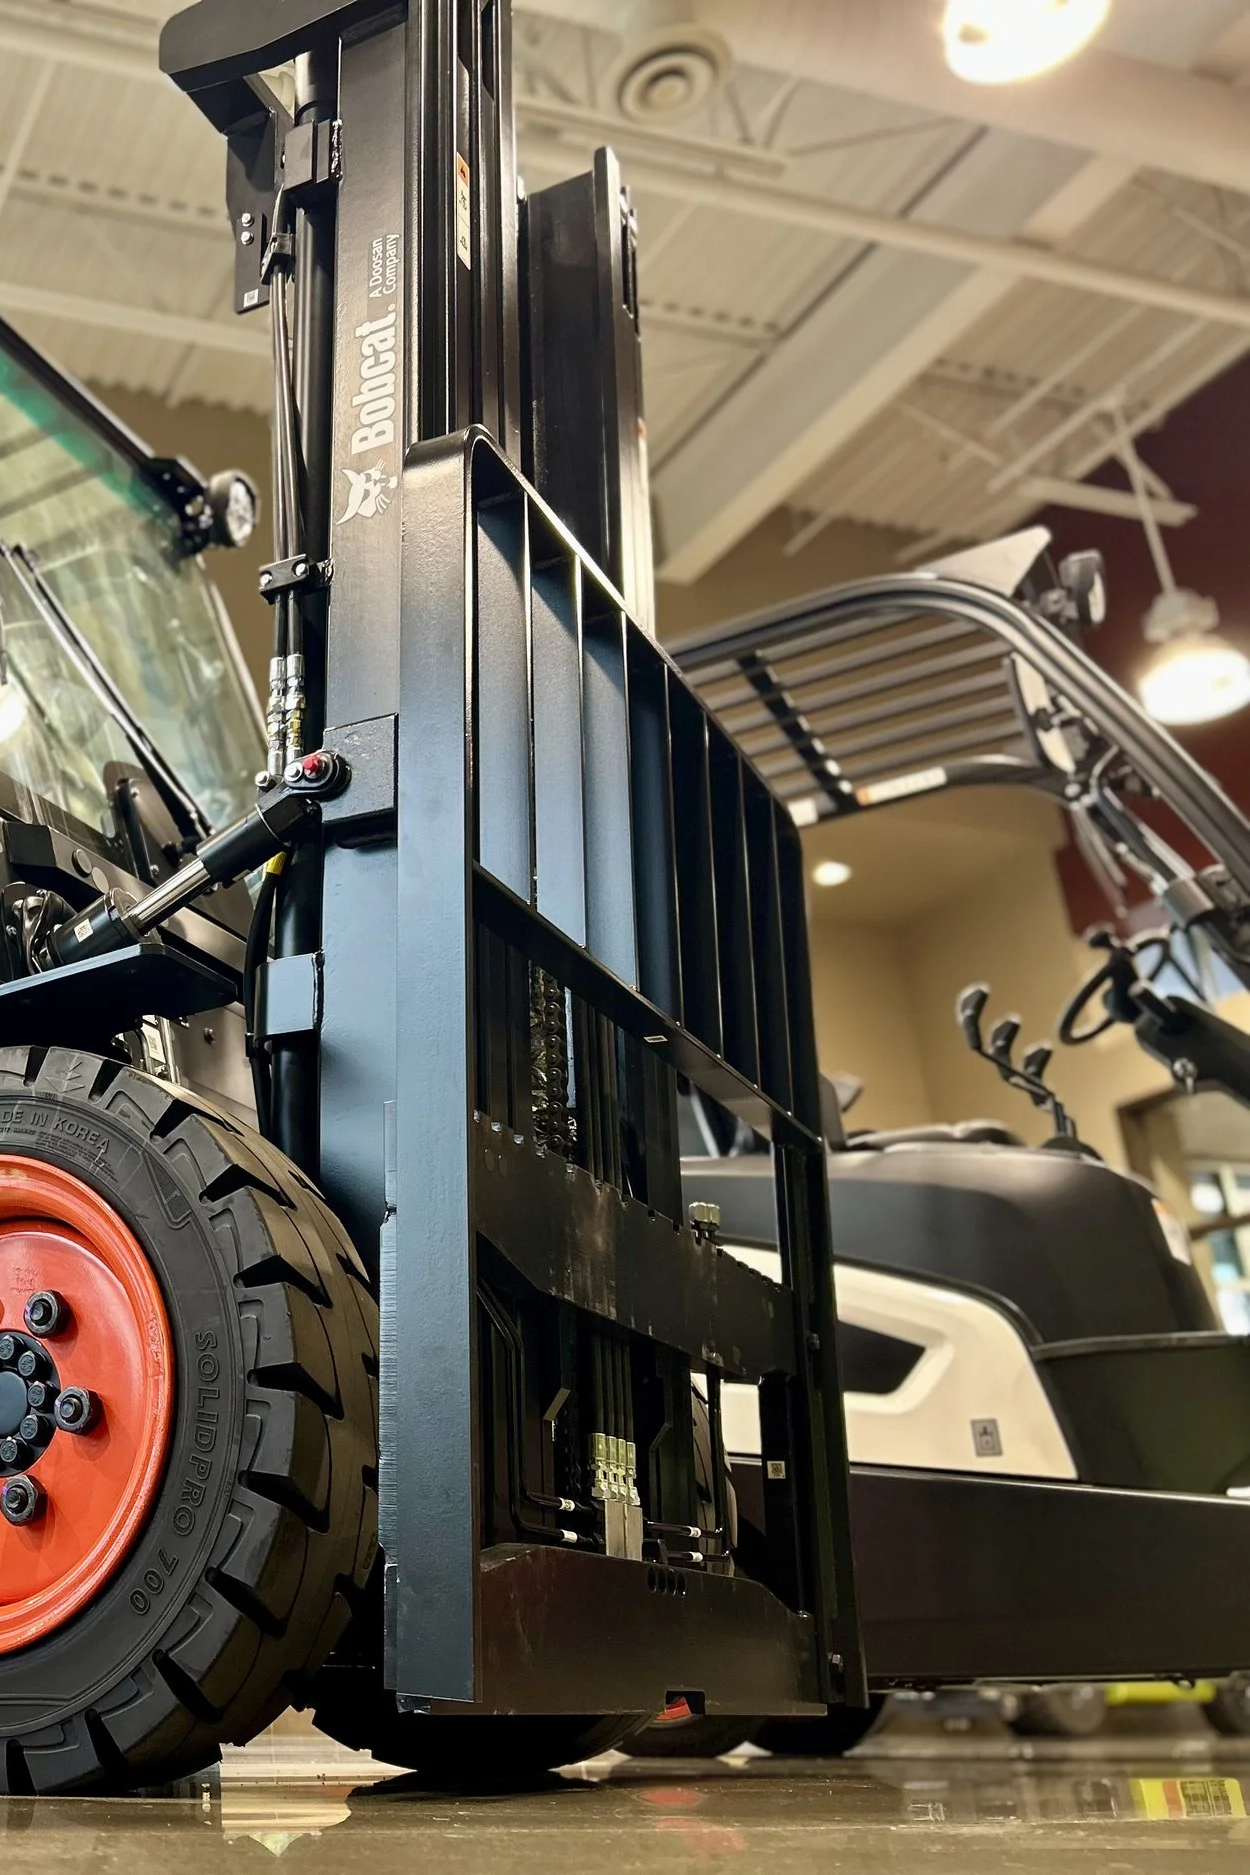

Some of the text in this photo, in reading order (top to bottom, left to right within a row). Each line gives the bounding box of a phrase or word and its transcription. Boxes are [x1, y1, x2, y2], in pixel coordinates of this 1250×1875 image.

[369, 237, 383, 298] A Doosan
[382, 234, 400, 295] Company
[31, 1113, 49, 1128] IN
[53, 1116, 111, 1152] KOREA
[129, 1329, 220, 1616] SOLIDPRO 700
